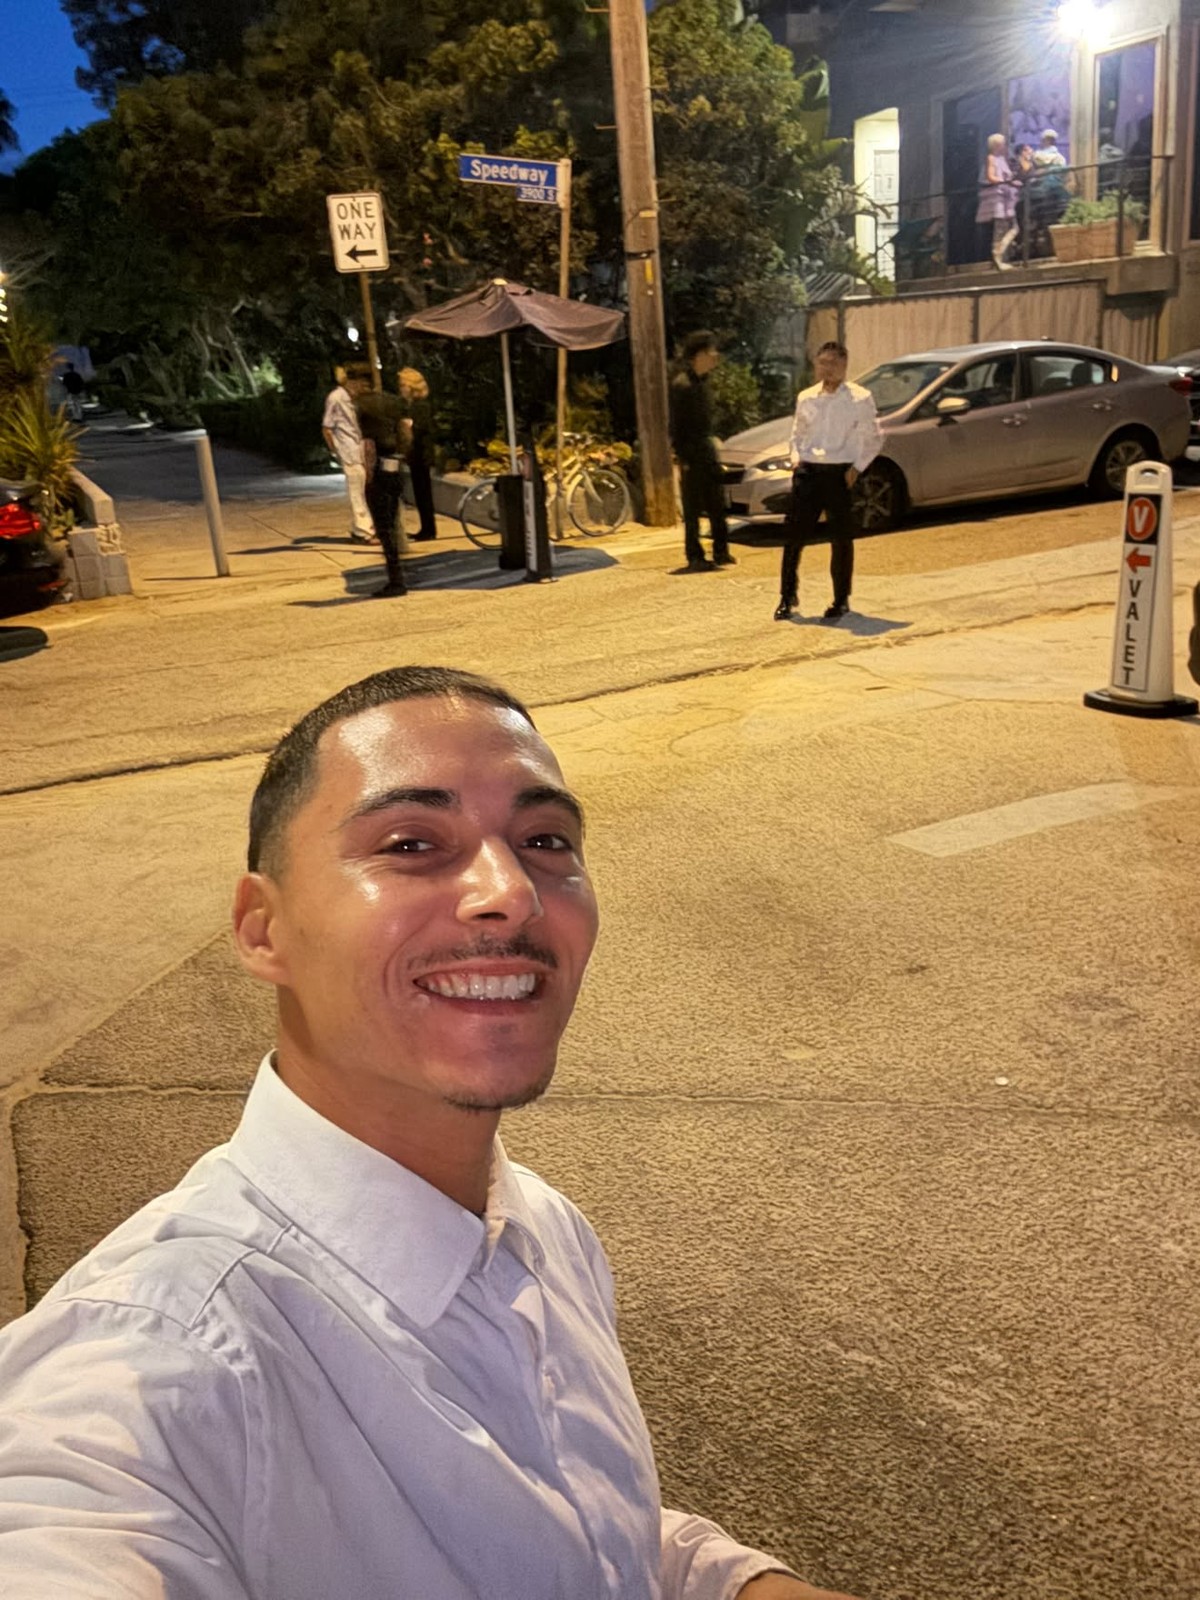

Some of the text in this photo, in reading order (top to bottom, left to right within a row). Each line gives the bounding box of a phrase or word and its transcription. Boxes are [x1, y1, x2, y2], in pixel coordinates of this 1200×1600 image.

[470, 159, 549, 187] Speedway
[547, 189, 555, 201] S
[336, 201, 376, 220] ONE
[337, 222, 377, 241] WAY
[1133, 506, 1149, 533] V
[1122, 579, 1142, 686] VALET
